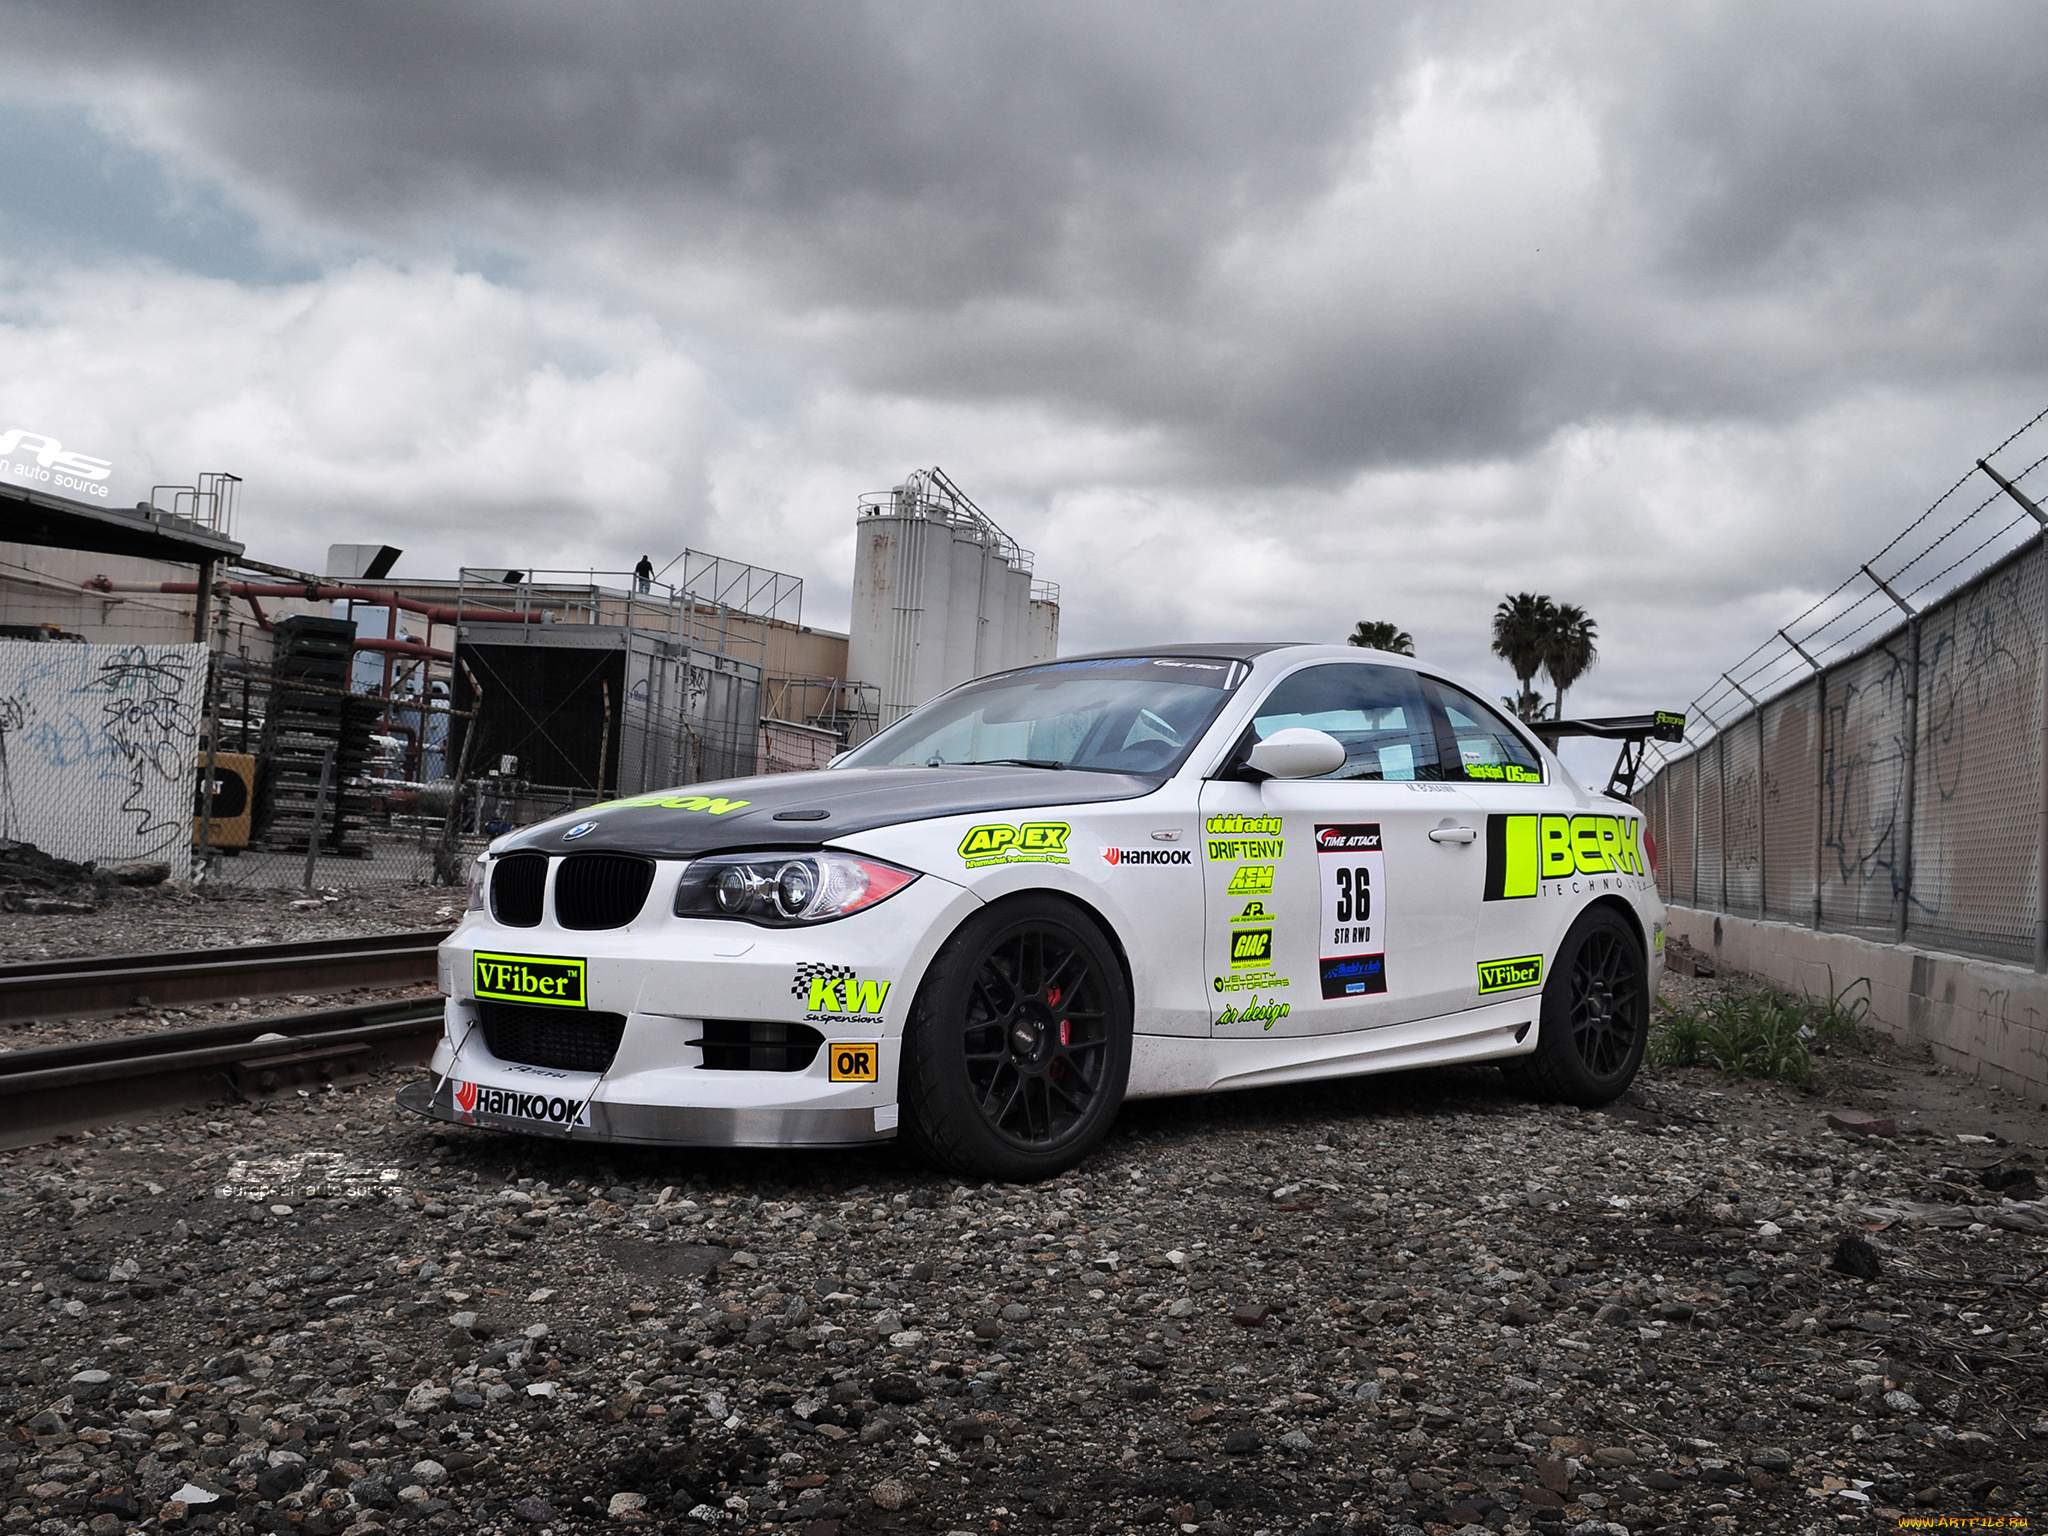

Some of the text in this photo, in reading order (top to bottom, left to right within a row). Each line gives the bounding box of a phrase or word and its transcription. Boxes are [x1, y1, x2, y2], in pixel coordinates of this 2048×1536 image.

[200, 779, 224, 795] CT
[1206, 814, 1282, 836] vividracing
[1208, 840, 1284, 860] DRIFTENVY
[1324, 835, 1379, 847] TIME ATTACK
[966, 854, 1070, 869] Aftermarket Performance Express
[1228, 865, 1275, 889] AEM
[1336, 867, 1370, 922] 36
[1234, 933, 1268, 957] GIAC
[1334, 927, 1370, 944] STR RWD
[1224, 971, 1277, 983] VELOCITY
[1224, 979, 1290, 992] MOTORCARS
[807, 977, 891, 1014] KW
[803, 1013, 884, 1025] suspensions
[1238, 994, 1290, 1031] design
[837, 1052, 870, 1075] OR
